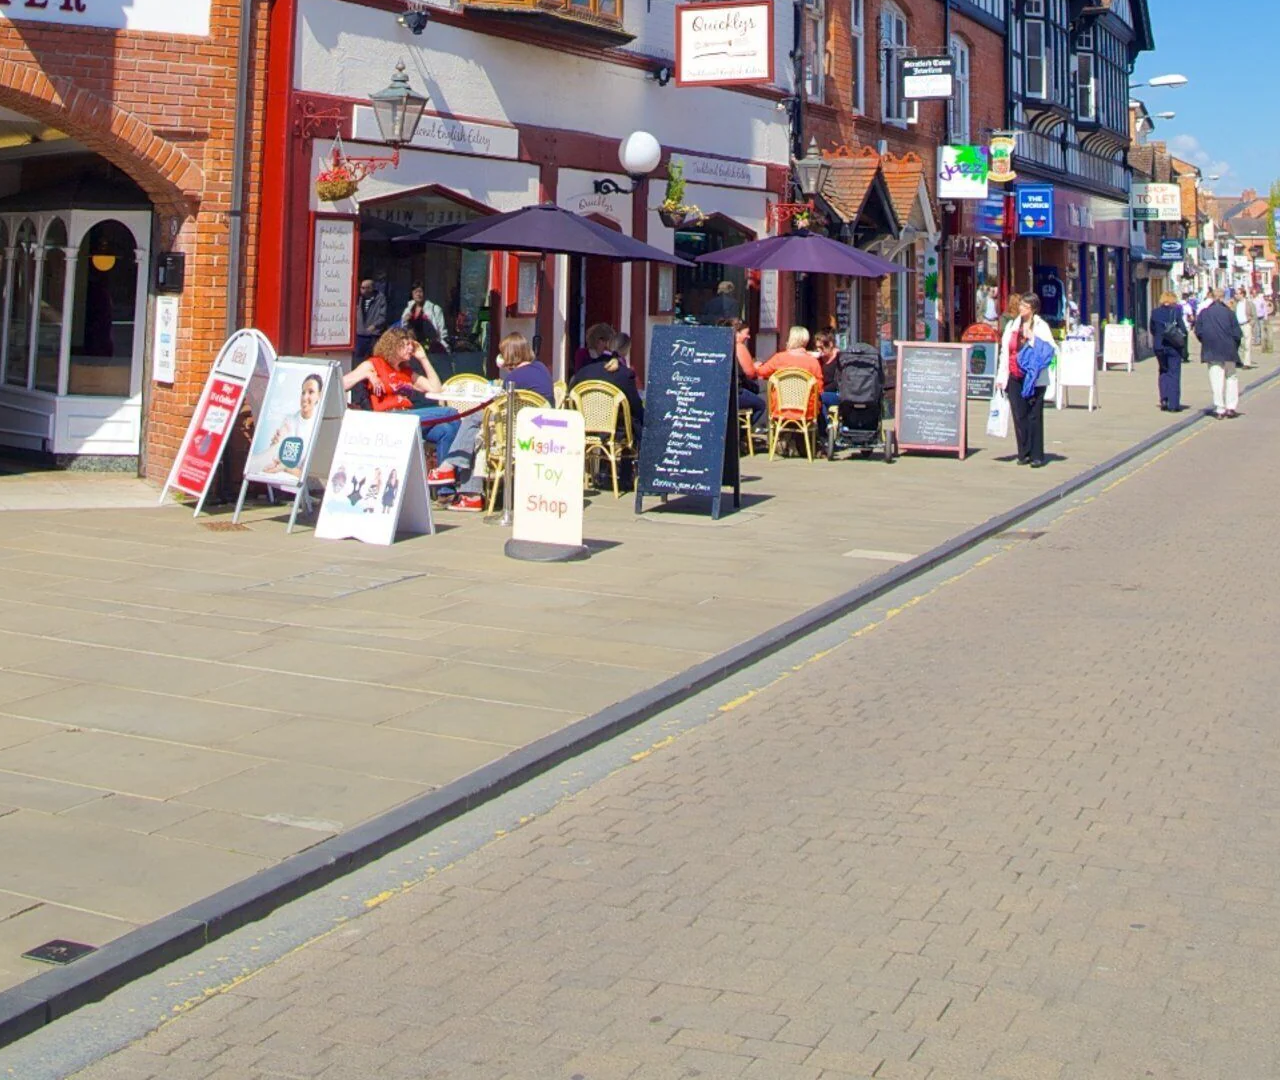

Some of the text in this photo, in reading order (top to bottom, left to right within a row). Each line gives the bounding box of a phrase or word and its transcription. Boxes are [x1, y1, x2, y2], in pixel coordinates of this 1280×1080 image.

[939, 160, 984, 181] jazz
[1136, 193, 1177, 205] TO LET
[671, 343, 680, 356] 7
[534, 463, 563, 487] Toy
[526, 494, 568, 519] Shop
